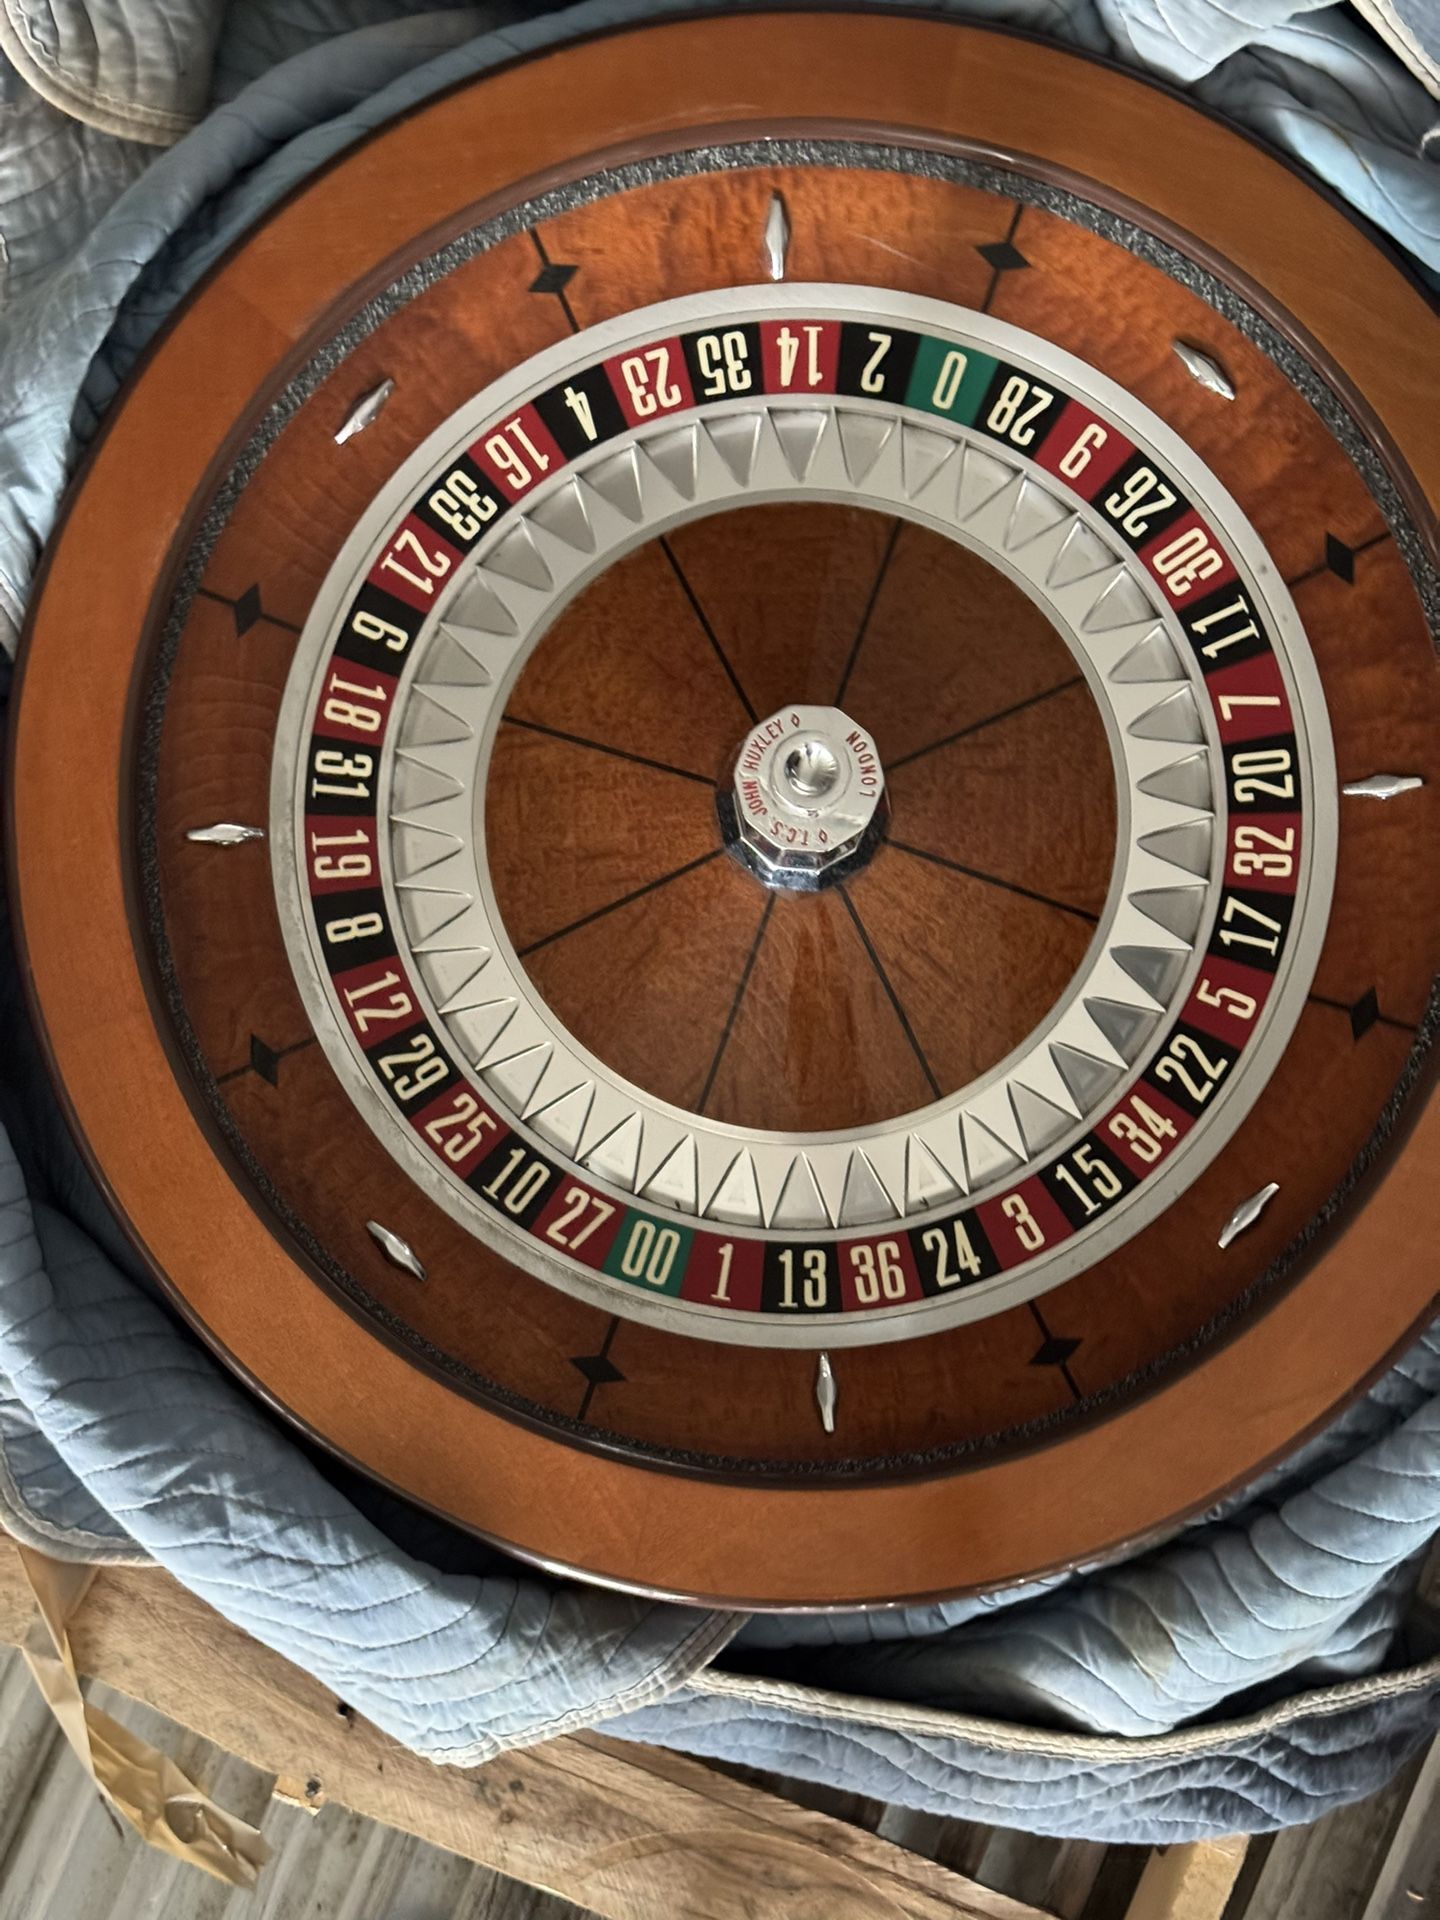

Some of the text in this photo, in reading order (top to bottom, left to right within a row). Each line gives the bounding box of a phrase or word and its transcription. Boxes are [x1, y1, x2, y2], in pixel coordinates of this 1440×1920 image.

[621, 347, 682, 416] 23
[697, 331, 751, 395] 35
[776, 326, 823, 386] 14
[861, 332, 891, 392] 2
[932, 351, 967, 409] 0
[564, 387, 597, 440] 4
[987, 376, 1053, 445] 28
[485, 417, 549, 489] 16
[1059, 423, 1107, 478] 9
[429, 470, 497, 540] 33
[1105, 467, 1177, 537] 26
[381, 529, 451, 594] 21
[1153, 528, 1223, 596] 30
[353, 611, 408, 651] 6
[1191, 595, 1259, 658] 11
[324, 673, 386, 731] 18
[1219, 696, 1280, 721] 7
[312, 751, 372, 797] 31
[743, 718, 784, 772] HUXLEY
[846, 731, 877, 798] LONDON
[742, 778, 768, 816] JOHN
[1232, 750, 1294, 802] 20
[312, 830, 371, 878] 19
[1234, 826, 1294, 876] 32
[326, 913, 383, 942] 8
[1220, 897, 1281, 955] 17
[344, 972, 412, 1032] 12
[1197, 980, 1256, 1018] 5
[379, 1034, 448, 1100] 29
[1156, 1035, 1227, 1102] 22
[425, 1093, 496, 1161] 25
[1109, 1096, 1177, 1162] 34
[483, 1149, 550, 1213] 10
[1056, 1144, 1122, 1215] 15
[547, 1187, 614, 1249] 27
[1002, 1195, 1044, 1250] 3
[622, 1220, 680, 1285] 00
[712, 1244, 733, 1300] 1
[779, 1250, 826, 1306] 13
[851, 1242, 905, 1302] 36
[923, 1221, 980, 1286] 24
